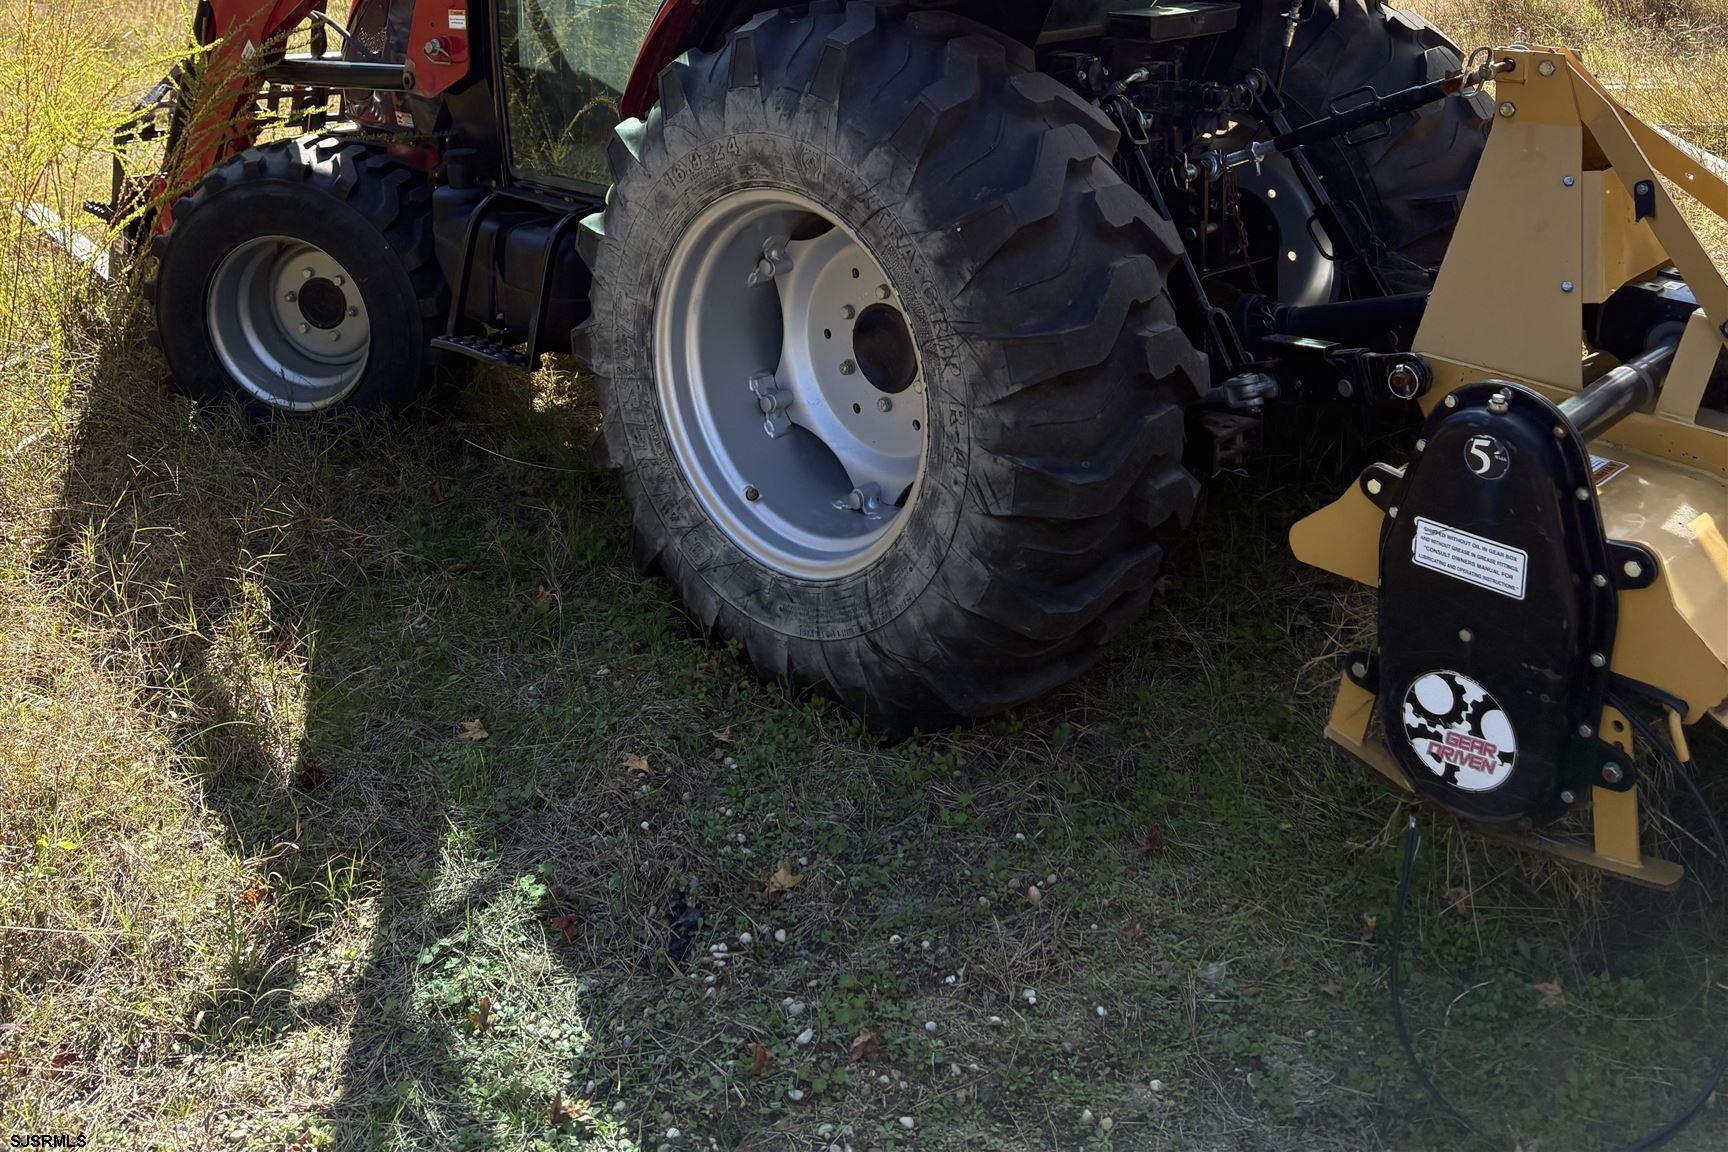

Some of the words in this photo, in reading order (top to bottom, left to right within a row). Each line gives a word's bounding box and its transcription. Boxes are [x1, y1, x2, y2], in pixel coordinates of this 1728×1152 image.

[1470, 438, 1491, 474] 5
[1431, 539, 1451, 549] WITHOUT
[1452, 545, 1470, 555] GREASE
[1477, 553, 1496, 565] GREASE
[1447, 535, 1471, 547] WITHOUT
[1489, 548, 1504, 558] GEAR
[1506, 554, 1517, 562] BOX
[1452, 555, 1475, 567] OWNERS
[1477, 562, 1500, 575] MANUAL
[1501, 572, 1513, 580] FOR
[1457, 567, 1481, 579] OPERATING
[1426, 740, 1498, 774] DRIVEN
[1445, 730, 1498, 758] GEAR
